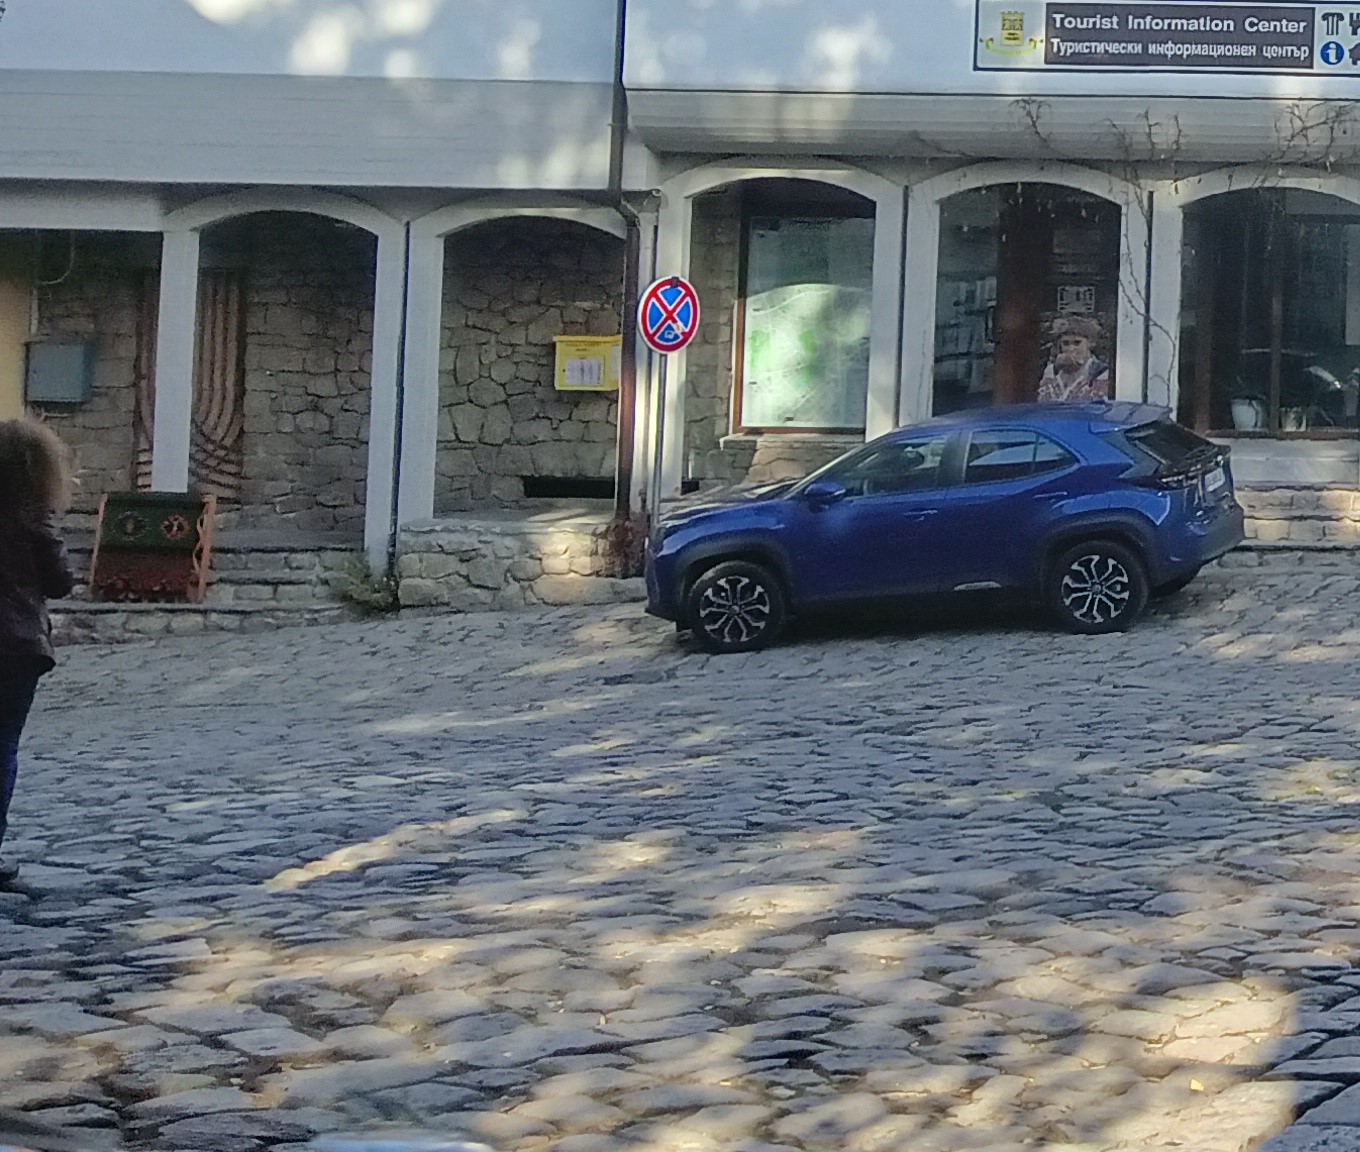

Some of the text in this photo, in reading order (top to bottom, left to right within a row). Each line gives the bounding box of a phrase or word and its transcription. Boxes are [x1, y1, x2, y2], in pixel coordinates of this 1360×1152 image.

[1052, 13, 1308, 33] Tourist Information Center
[1050, 38, 1310, 61] Туристически информационен център
